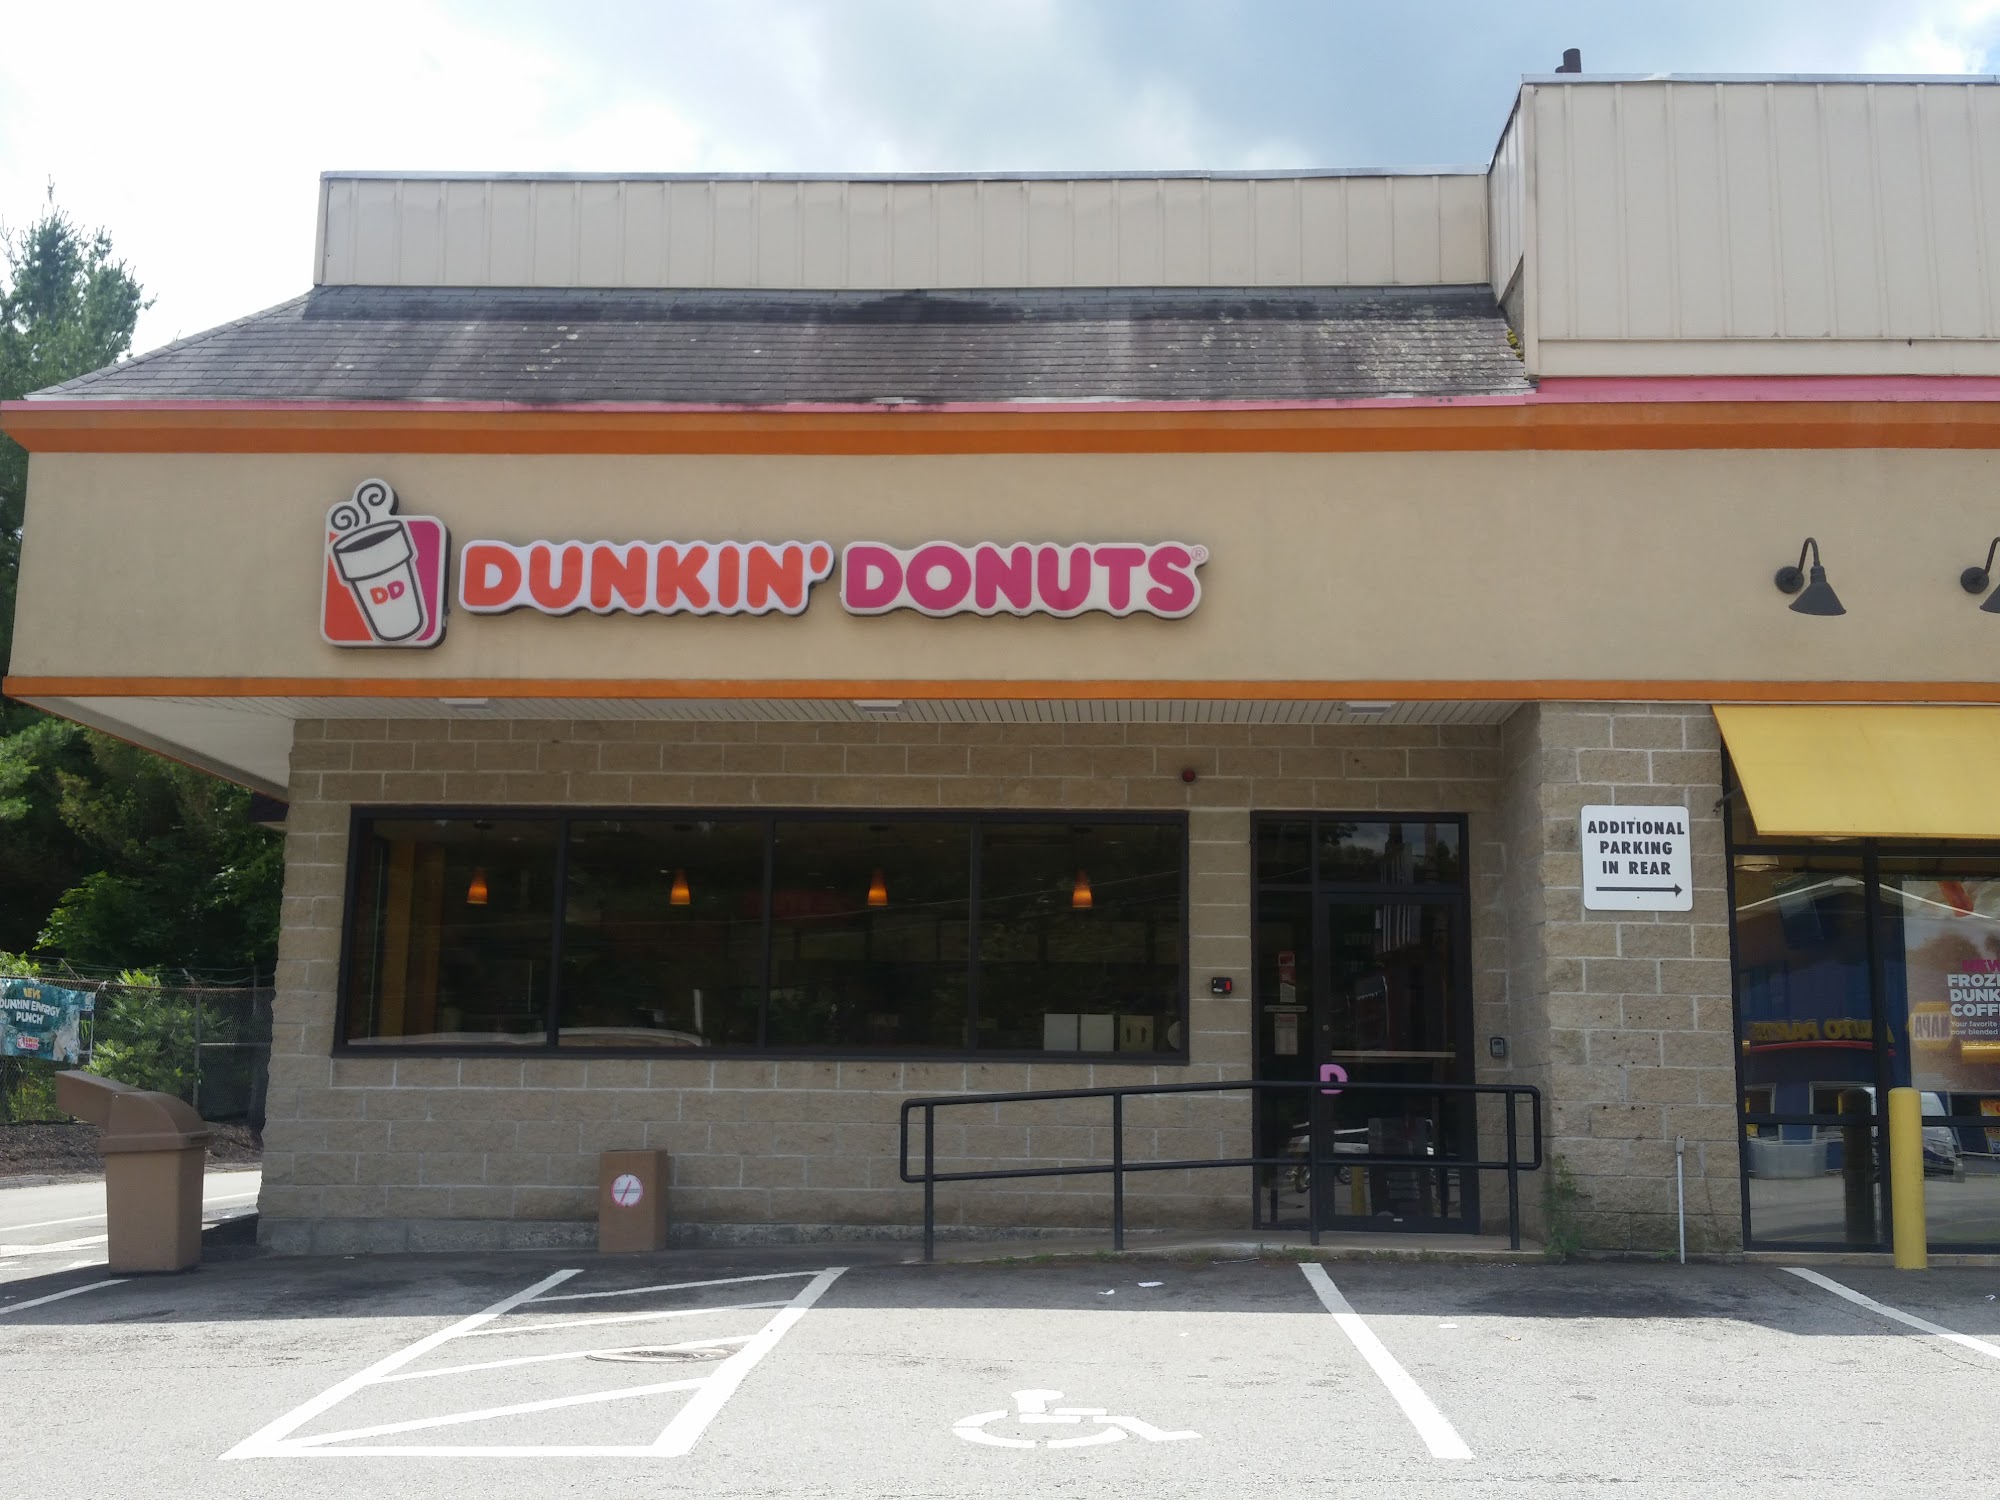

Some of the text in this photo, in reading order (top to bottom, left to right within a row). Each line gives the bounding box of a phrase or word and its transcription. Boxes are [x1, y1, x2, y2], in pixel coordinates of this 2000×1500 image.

[463, 545, 830, 609] DUNKIN'
[370, 580, 405, 605] DD
[1587, 821, 1685, 835] ADDITIONAL
[1600, 841, 1673, 855] PARKING
[1602, 861, 1671, 875] IN REAR
[1947, 974, 2000, 987] FROZ
[1951, 1003, 2000, 1017] COFF
[16, 1012, 44, 1024] PUNCH
